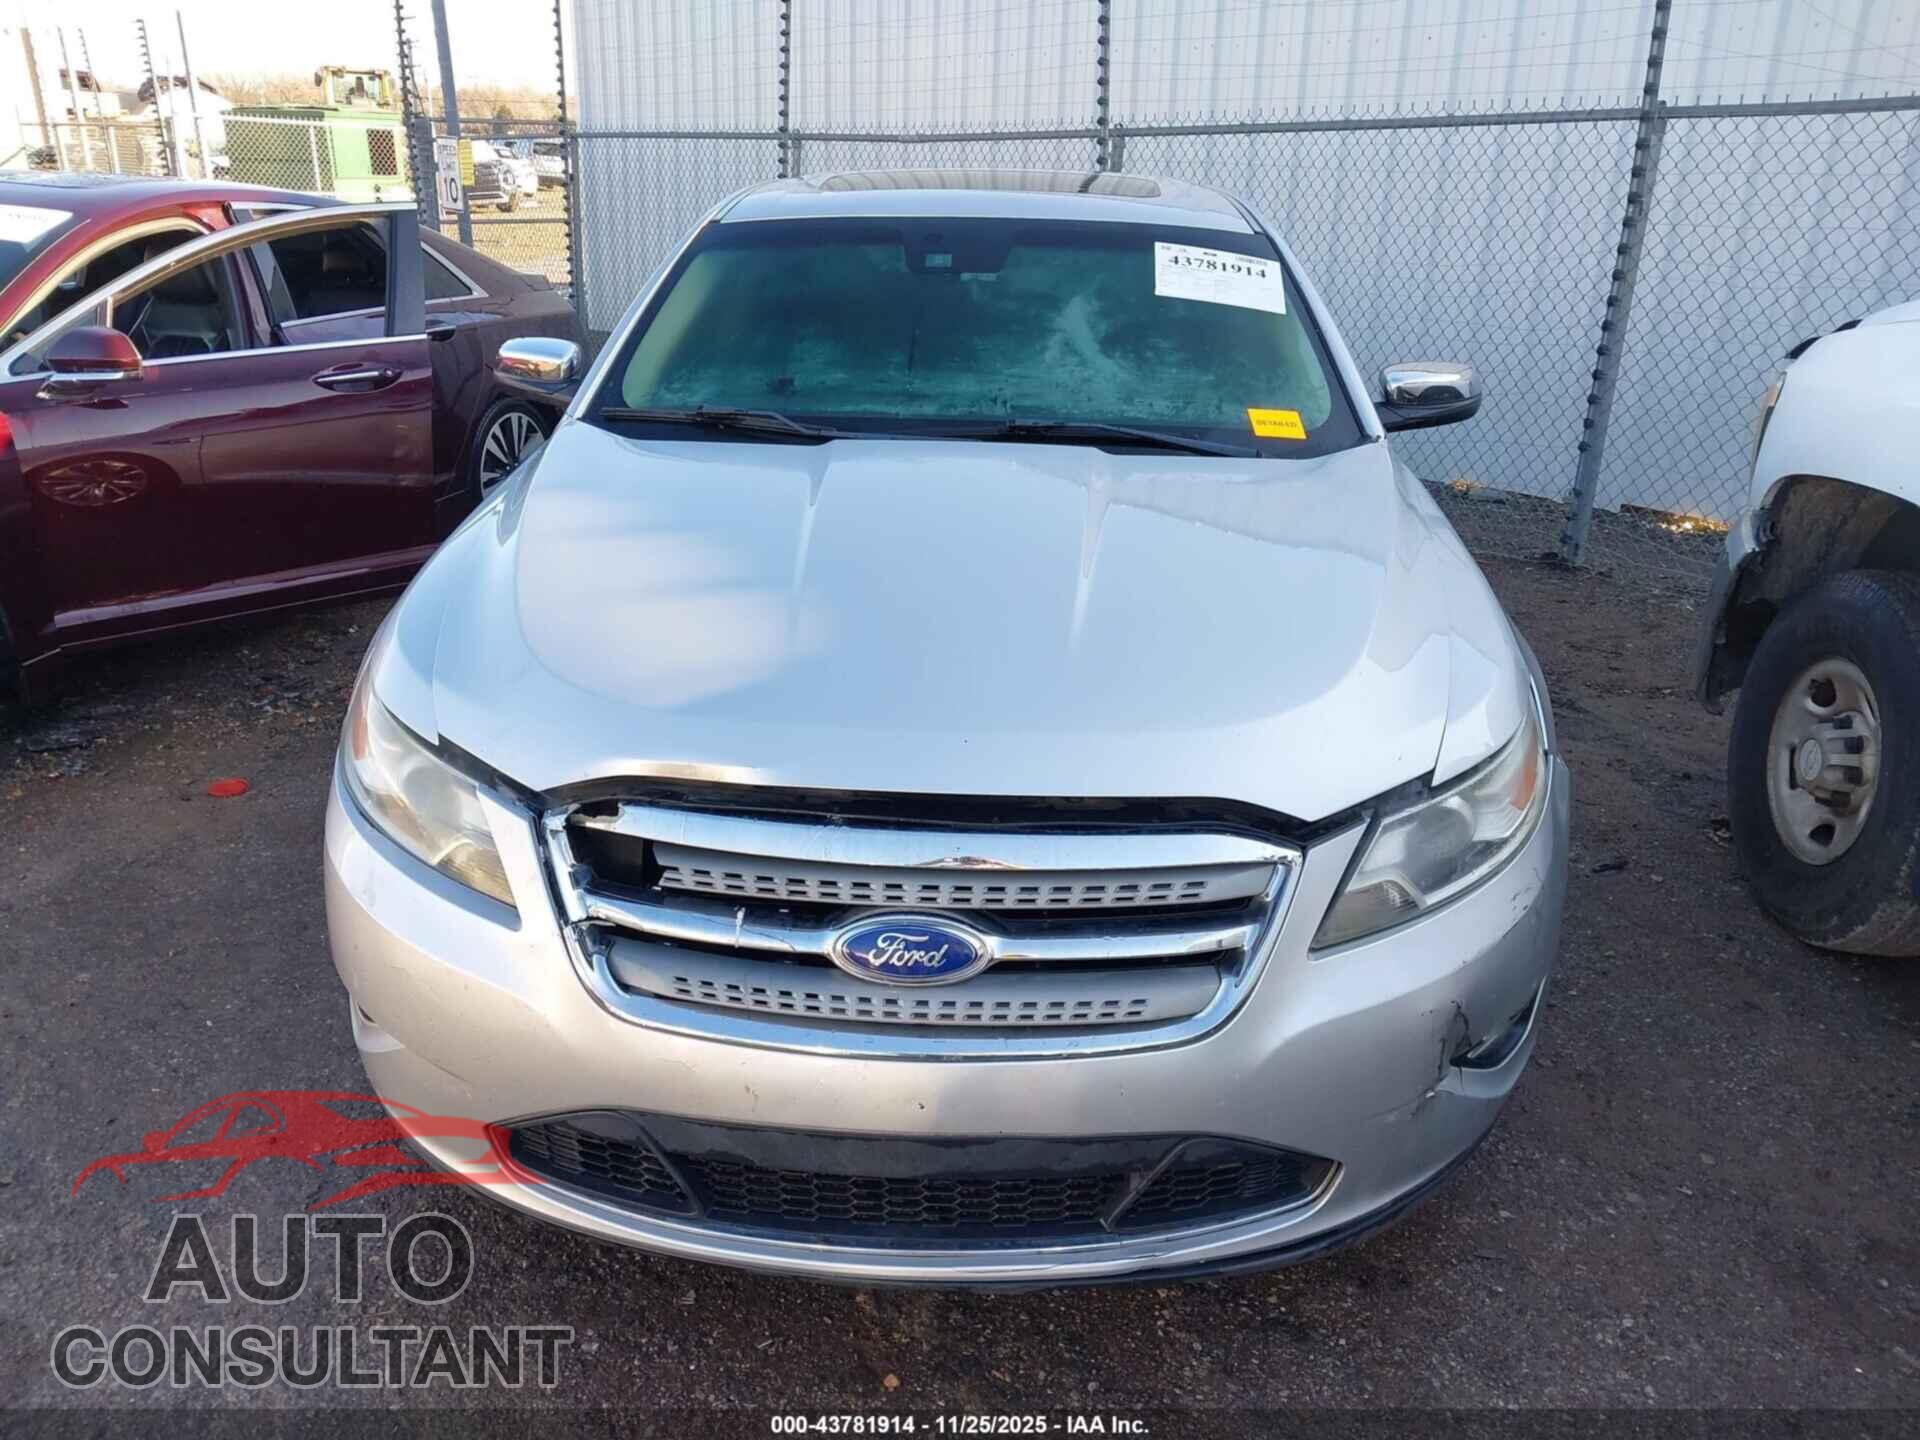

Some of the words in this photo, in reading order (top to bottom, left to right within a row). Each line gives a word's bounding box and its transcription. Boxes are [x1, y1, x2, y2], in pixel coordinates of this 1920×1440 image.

[444, 177, 459, 204] 10
[1168, 254, 1267, 279] 43781914
[855, 932, 949, 968] Ford
